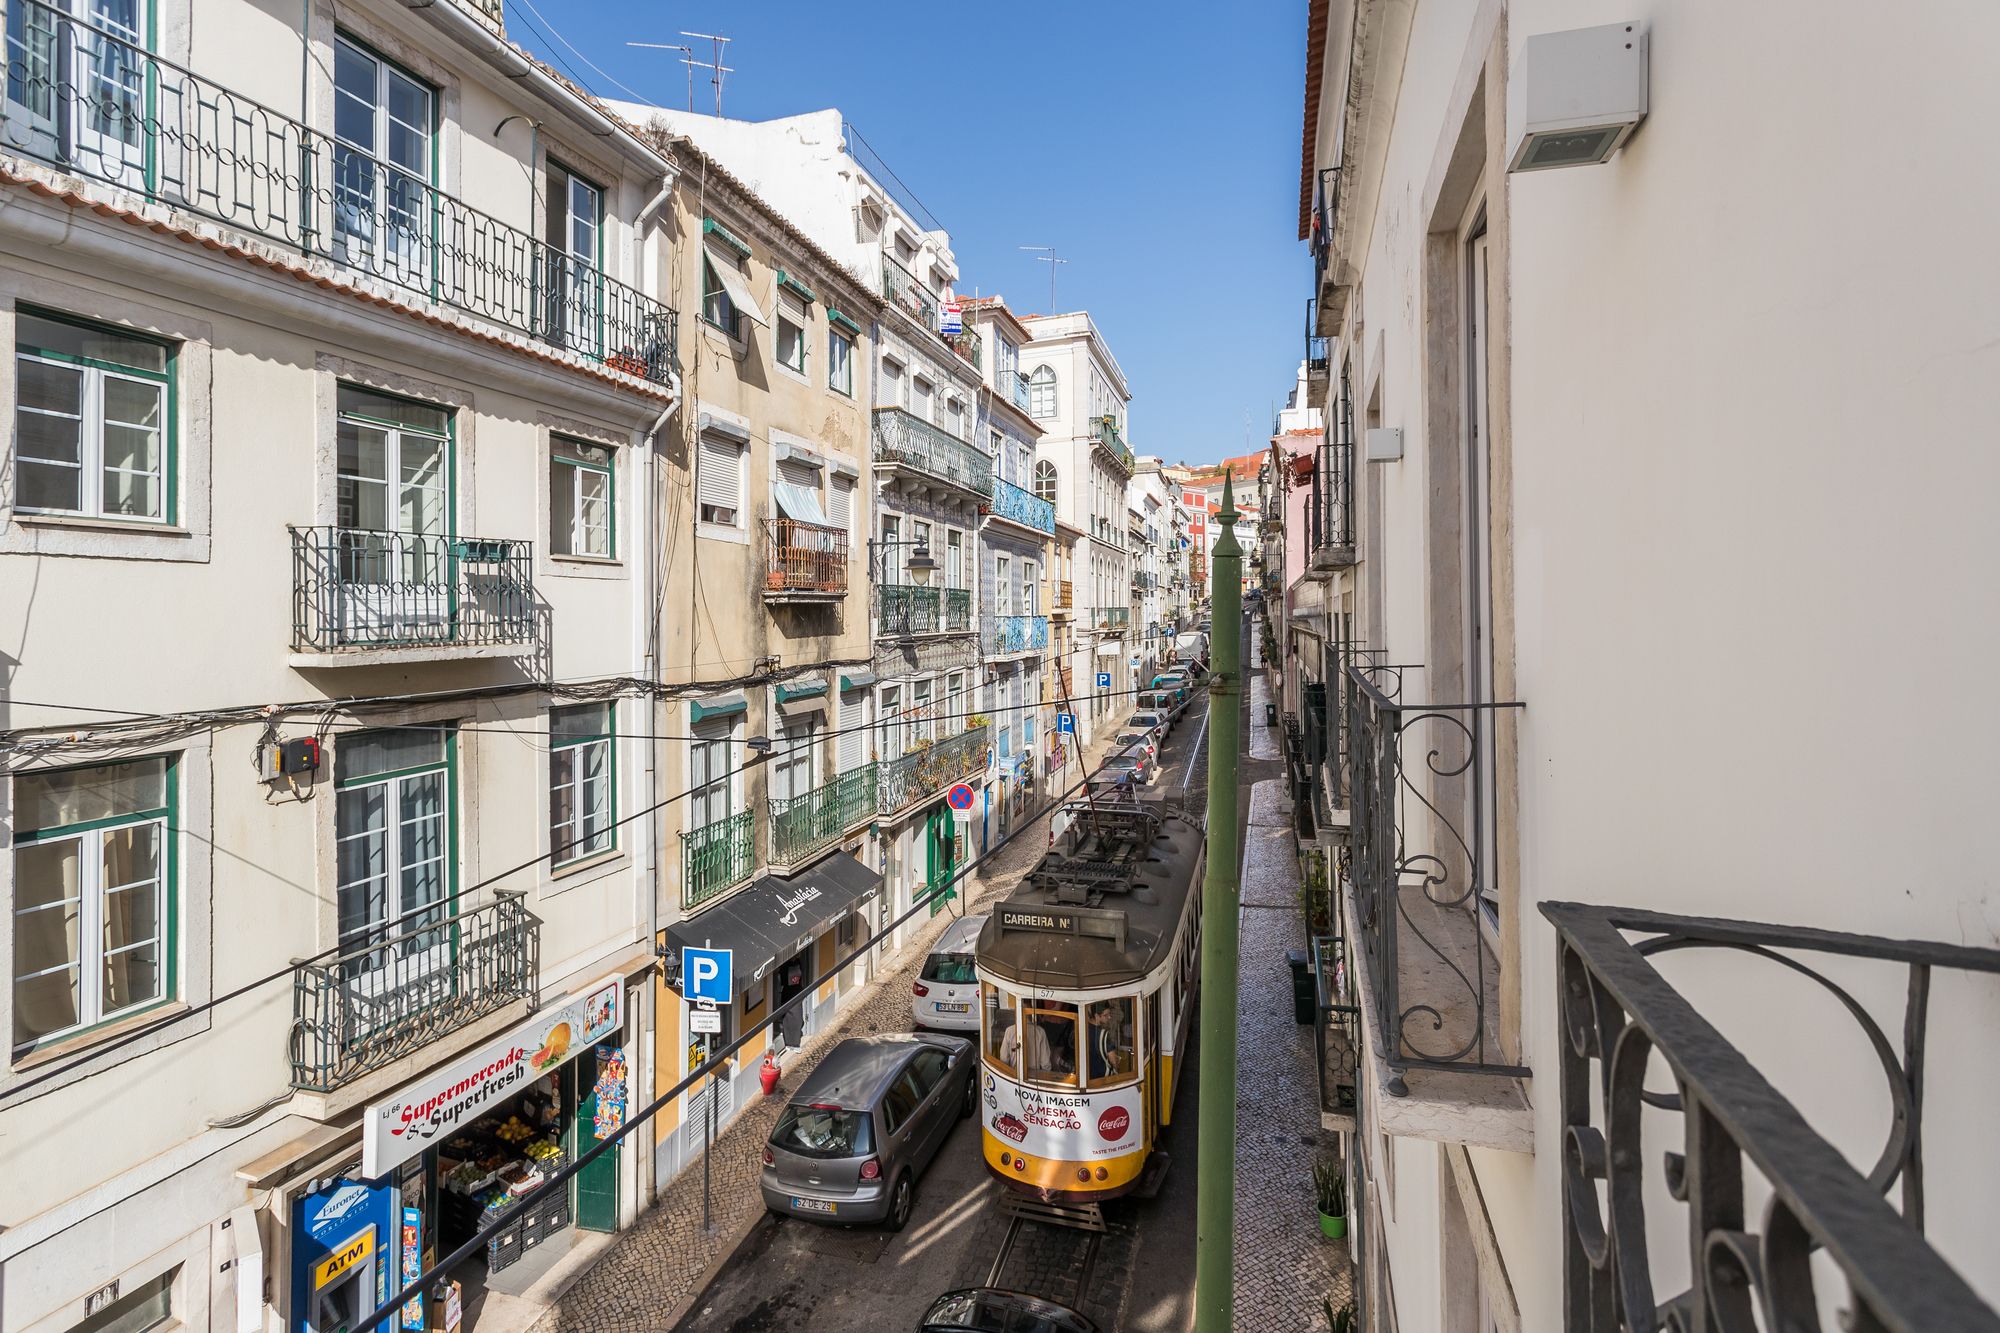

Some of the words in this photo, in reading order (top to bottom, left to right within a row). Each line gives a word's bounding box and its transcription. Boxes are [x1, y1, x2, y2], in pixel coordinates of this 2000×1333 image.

[1099, 675, 1108, 686] P
[1061, 715, 1071, 732] P
[1004, 913, 1054, 928] CARREIRA
[693, 956, 719, 994] P
[1040, 989, 1055, 998] 577
[391, 1046, 524, 1136] Supermercado
[1014, 1087, 1043, 1104] NOVA
[1046, 1097, 1091, 1107] IMAGEM
[420, 1062, 524, 1139] Superfresh
[1027, 1103, 1035, 1113] A
[1037, 1106, 1077, 1118] MESMA
[1023, 1113, 1082, 1130] SENSAÇÃO
[1099, 1115, 1128, 1131] Coca-Cola
[1117, 1143, 1136, 1151] FEELING
[322, 1189, 361, 1216] Euronet
[326, 1242, 364, 1278] ATM
